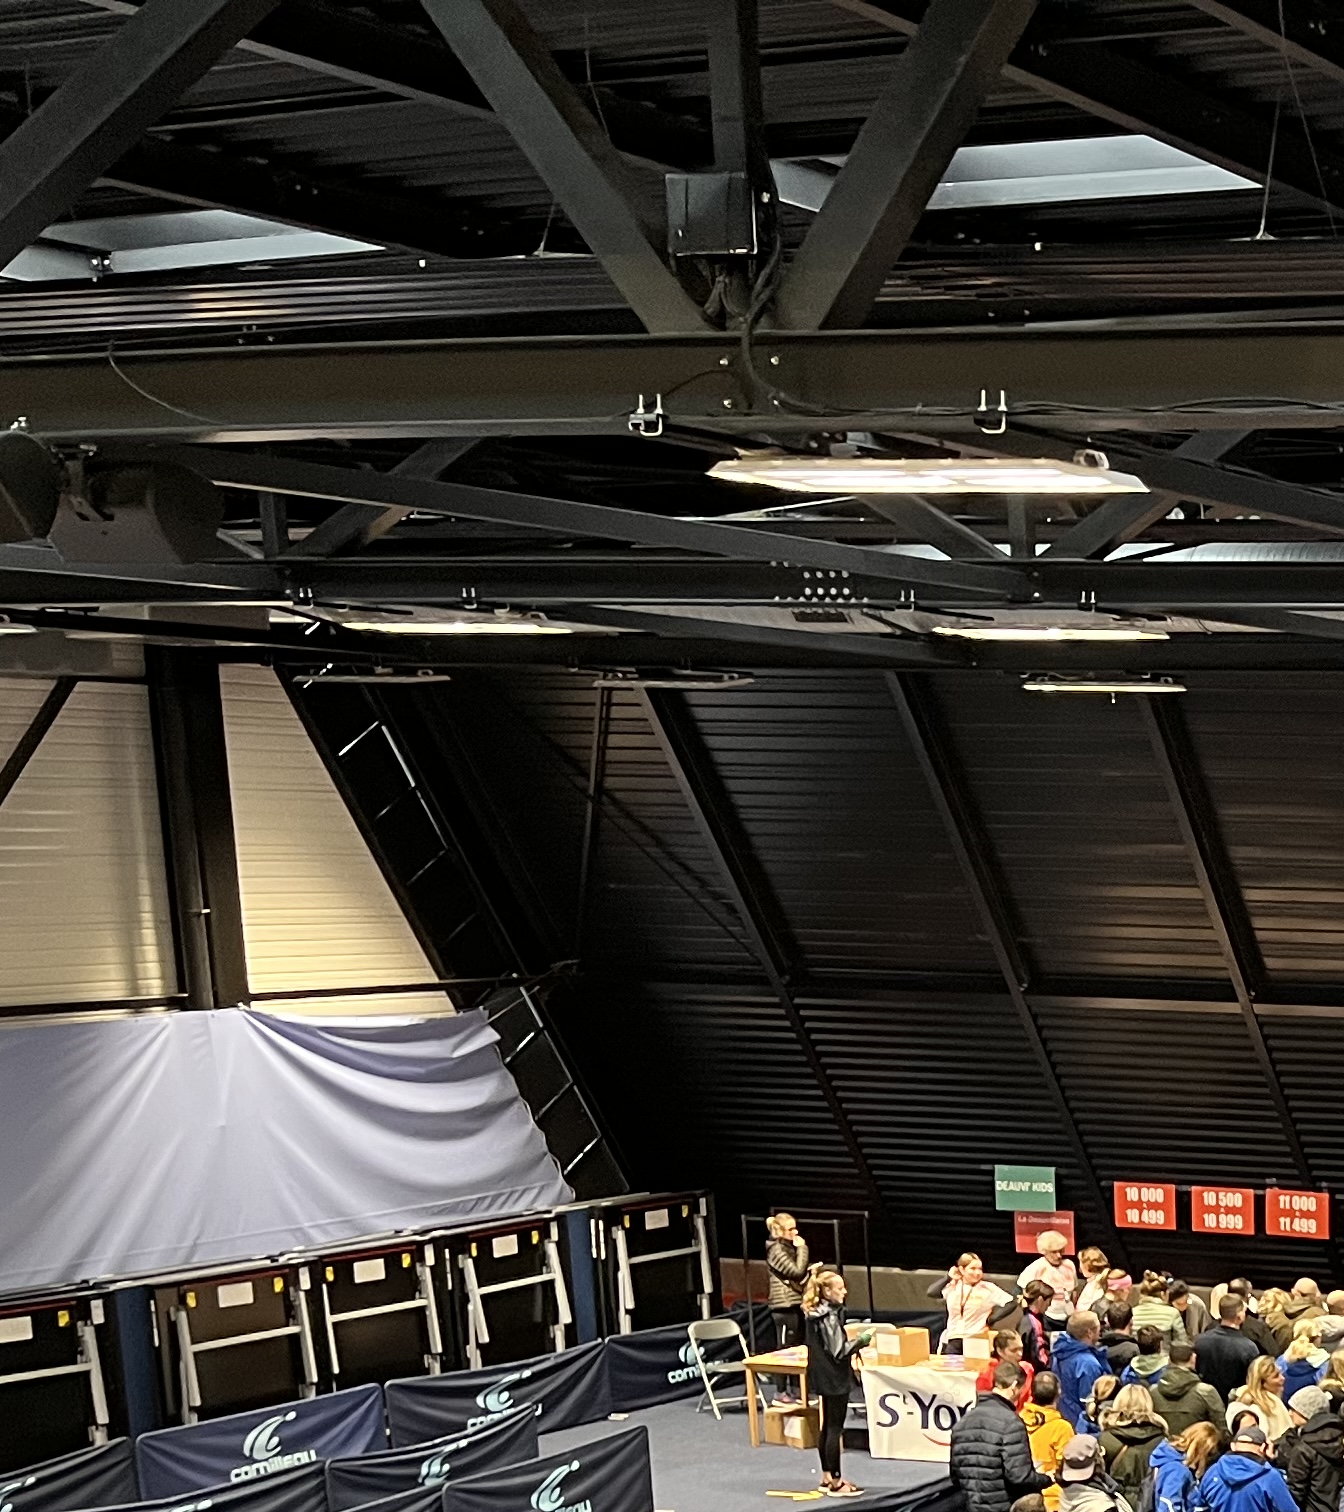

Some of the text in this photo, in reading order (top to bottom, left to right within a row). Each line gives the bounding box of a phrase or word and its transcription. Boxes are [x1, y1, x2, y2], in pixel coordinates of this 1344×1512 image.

[1125, 1187, 1164, 1203] 10 000
[1203, 1191, 1242, 1208] 10 500
[1278, 1194, 1316, 1211] 11 000
[1125, 1209, 1165, 1225] 10 499
[1203, 1214, 1243, 1229] 10 999
[1278, 1217, 1317, 1233] 11 499
